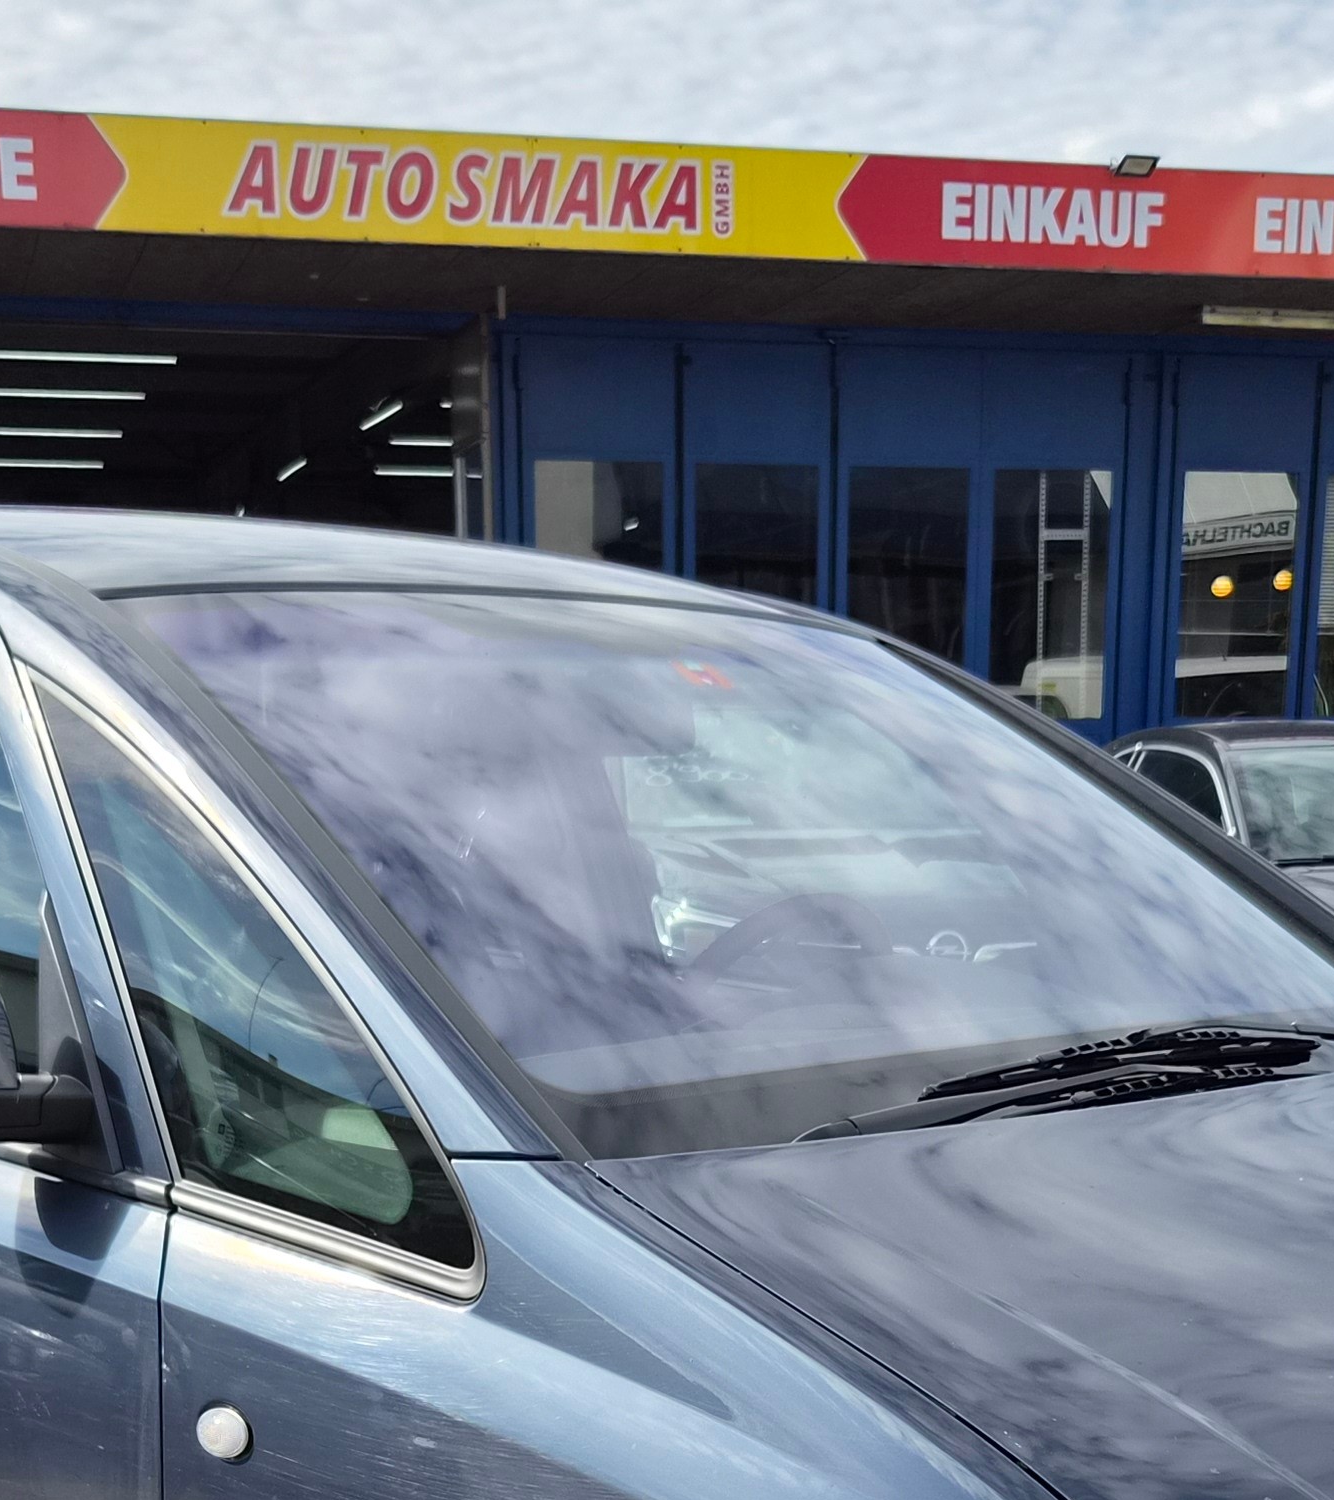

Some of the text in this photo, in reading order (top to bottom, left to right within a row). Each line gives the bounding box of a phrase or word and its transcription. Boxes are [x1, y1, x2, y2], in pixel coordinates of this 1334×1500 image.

[225, 142, 701, 232] AUTO SMAKA
[714, 163, 732, 236] GMBH
[941, 181, 1165, 249] EINKAUF
